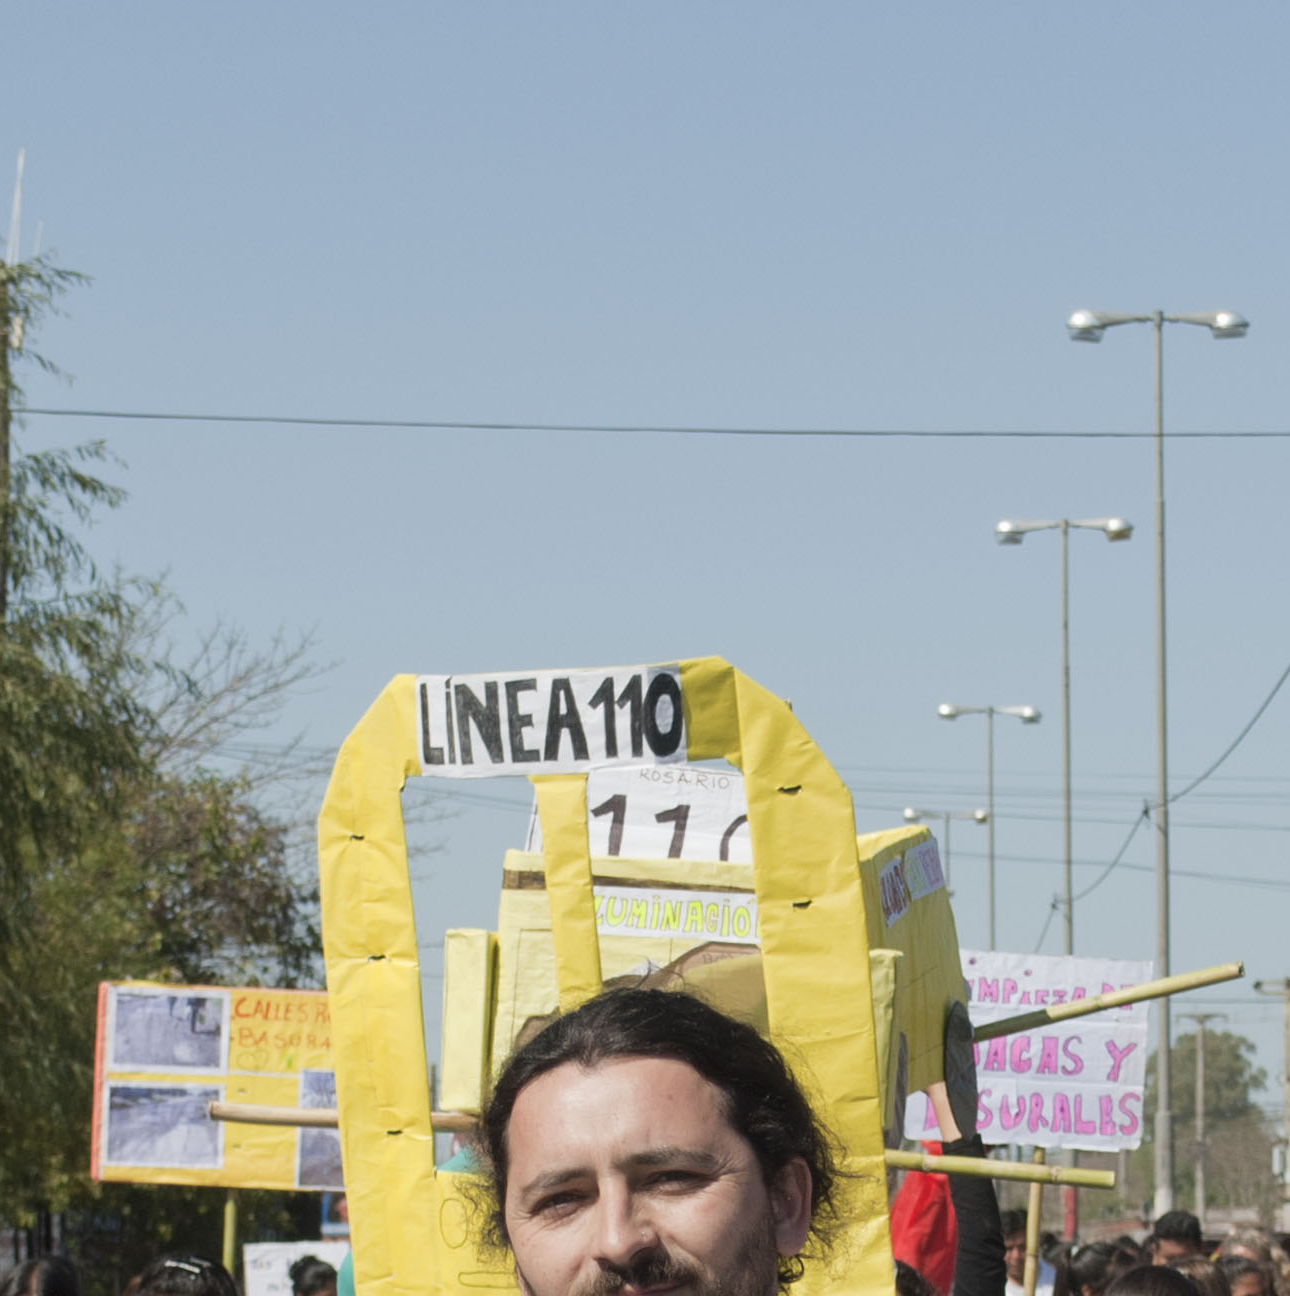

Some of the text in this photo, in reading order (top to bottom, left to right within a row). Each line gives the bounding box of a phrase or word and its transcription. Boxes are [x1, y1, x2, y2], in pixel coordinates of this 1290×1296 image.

[588, 673, 684, 758] 110
[639, 768, 730, 790] ROSARIO
[1104, 1040, 1137, 1082] Y
